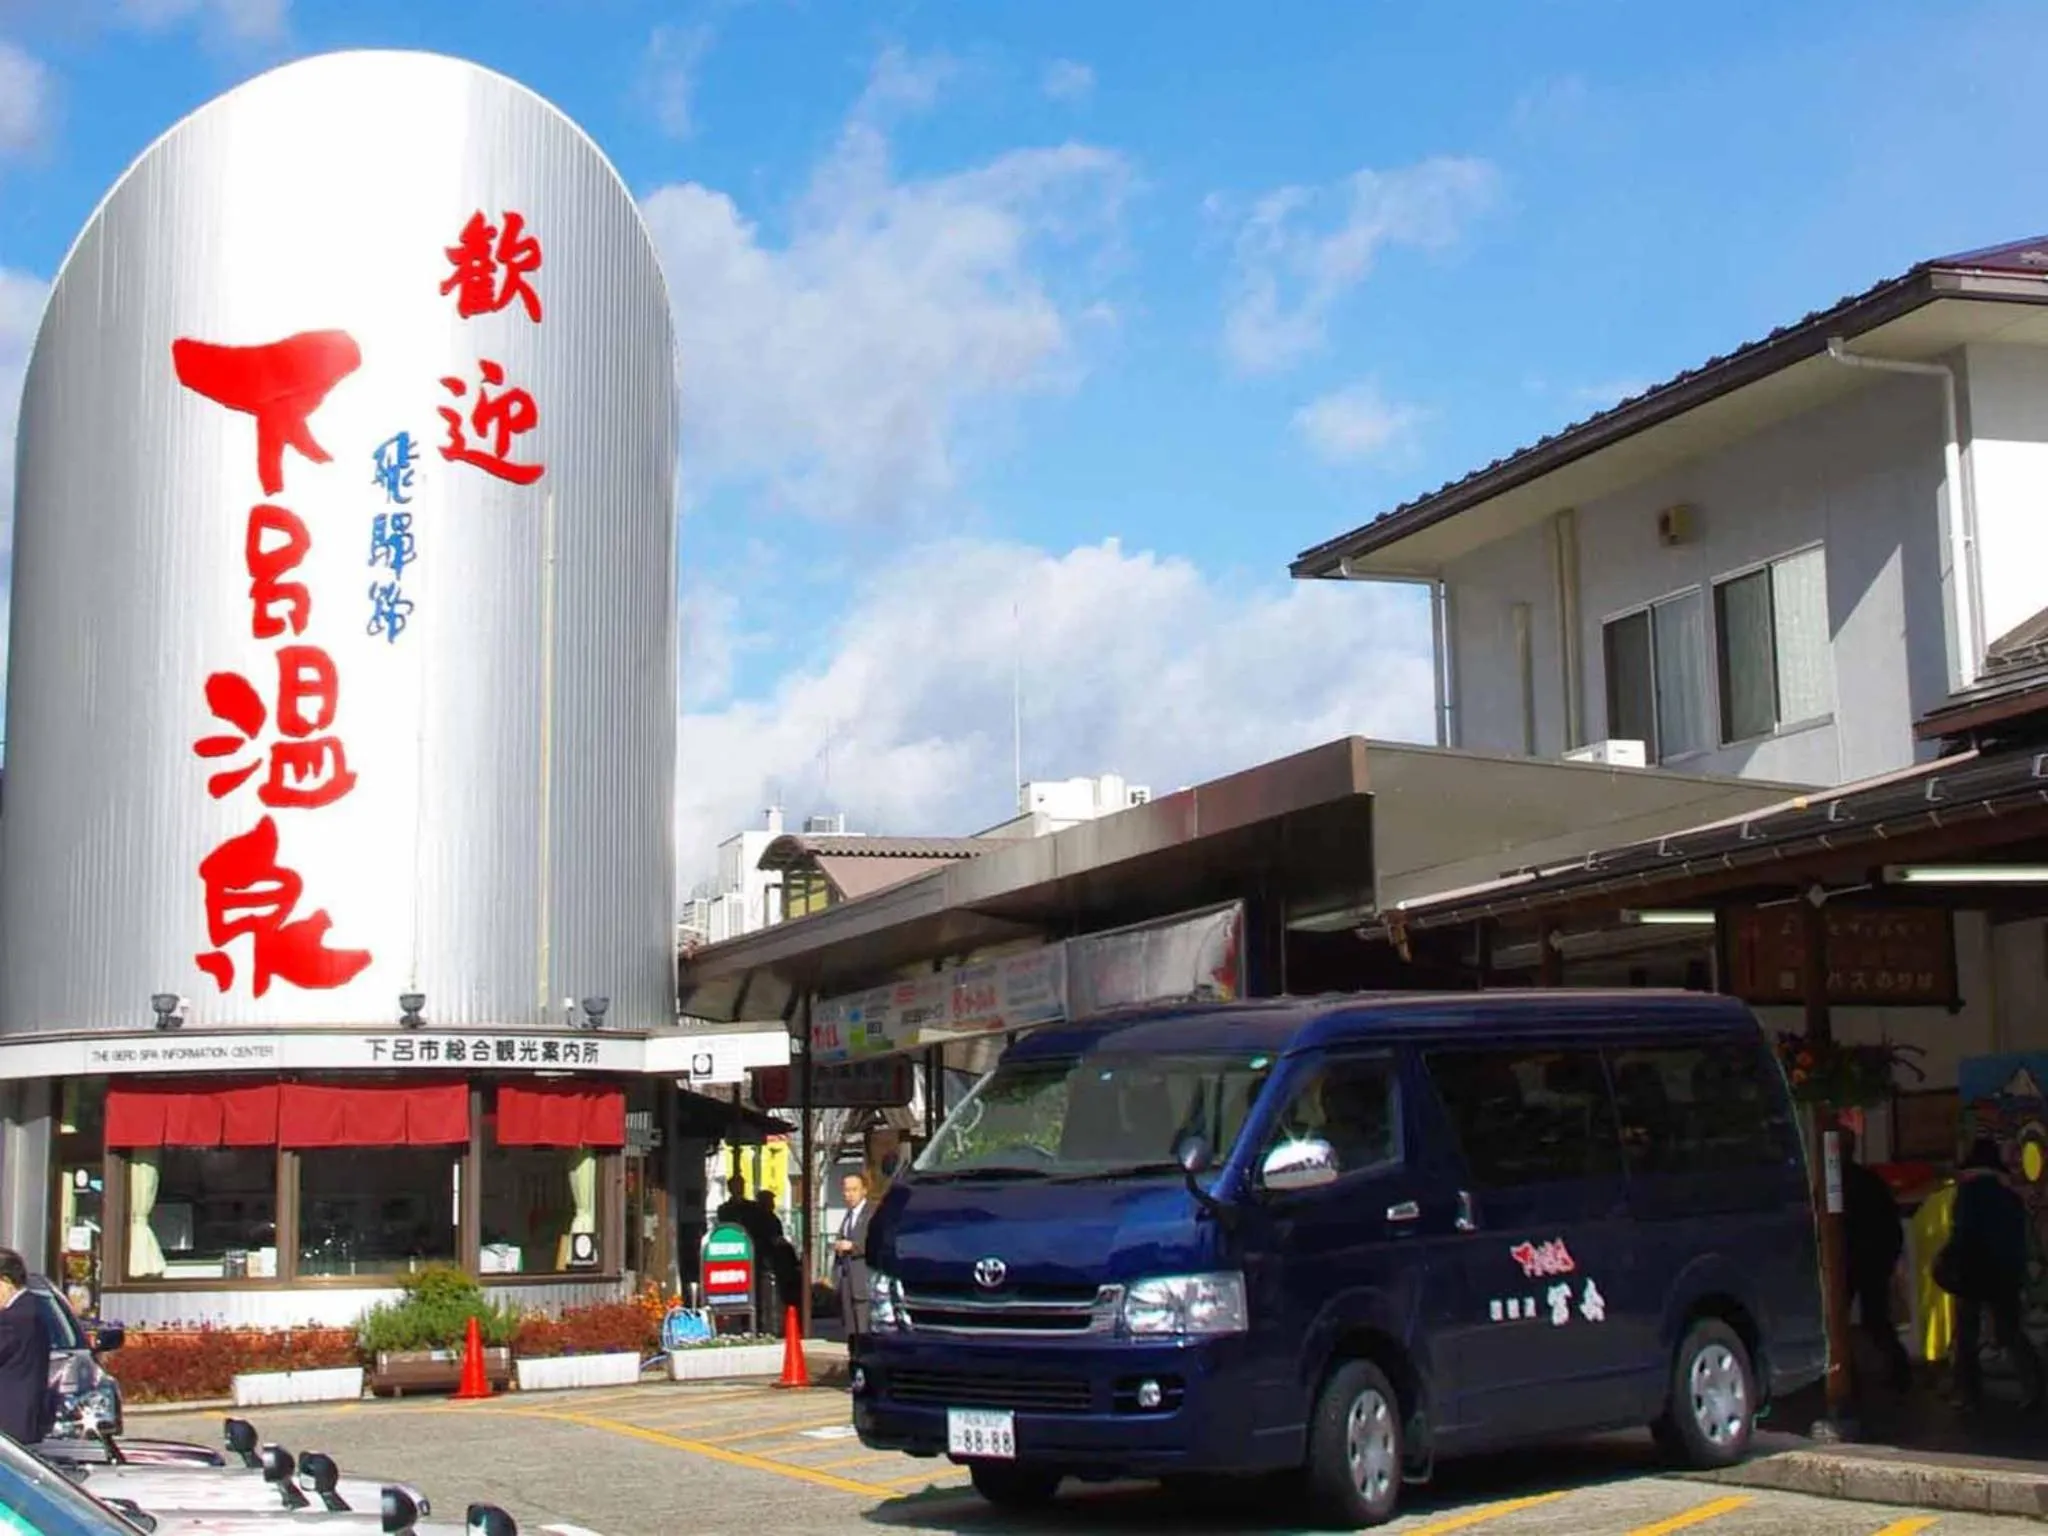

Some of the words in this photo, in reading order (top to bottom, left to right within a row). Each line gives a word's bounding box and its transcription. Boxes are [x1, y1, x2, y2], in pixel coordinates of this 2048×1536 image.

[438, 209, 544, 485] 歓迎
[172, 329, 371, 998] 下呂温泉
[161, 1047, 228, 1060] INFORMATION
[231, 1045, 273, 1058] CENTER
[365, 1038, 599, 1063] 下呂市総合観光案内所
